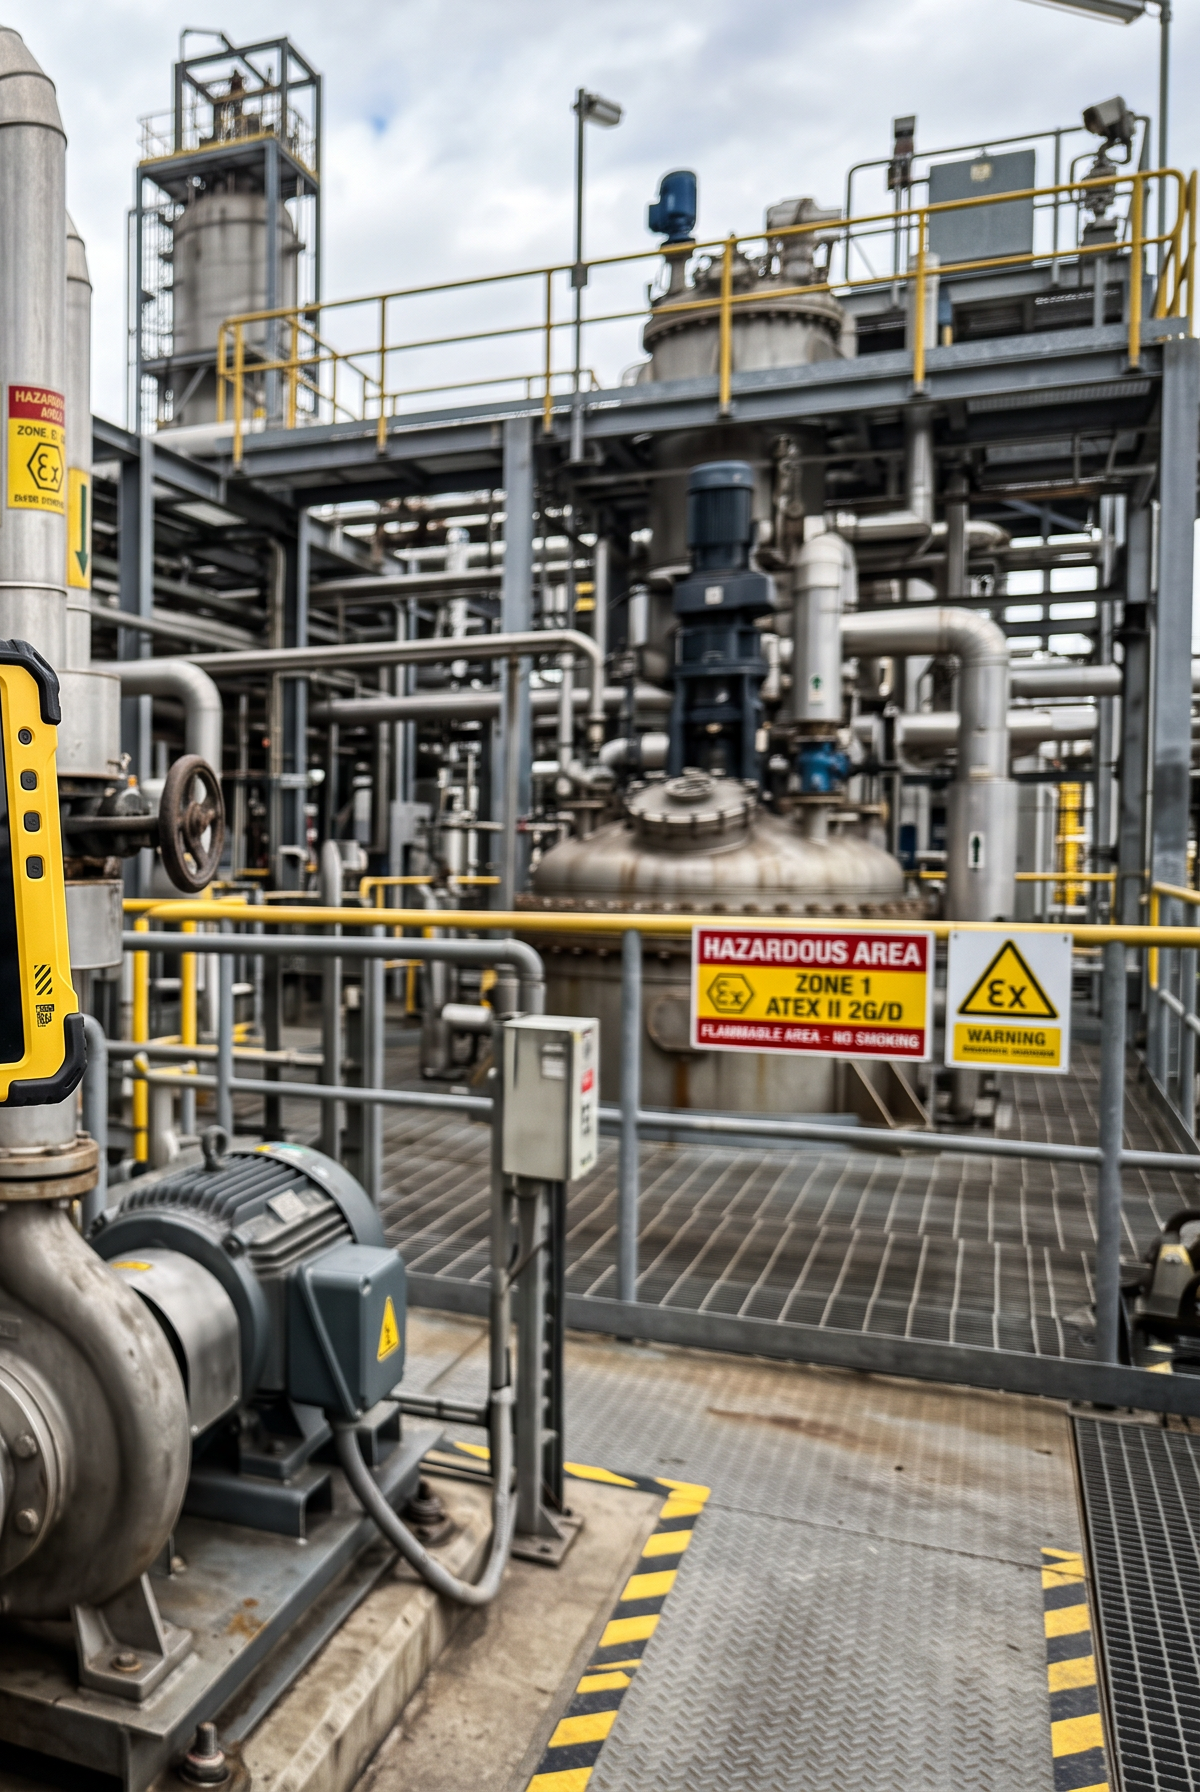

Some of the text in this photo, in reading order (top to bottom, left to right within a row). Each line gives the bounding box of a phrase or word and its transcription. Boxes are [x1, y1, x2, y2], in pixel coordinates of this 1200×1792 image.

[703, 936, 922, 967] HAZARDOUS AREA
[714, 980, 745, 1007] Ex
[795, 972, 871, 996] ZONE 1
[987, 979, 1028, 1009] Ex
[765, 997, 903, 1022] ATEX II 2G/D
[784, 1028, 821, 1044] AREA
[855, 1032, 920, 1049] SMOKING
[966, 1028, 1046, 1047] WARNING
